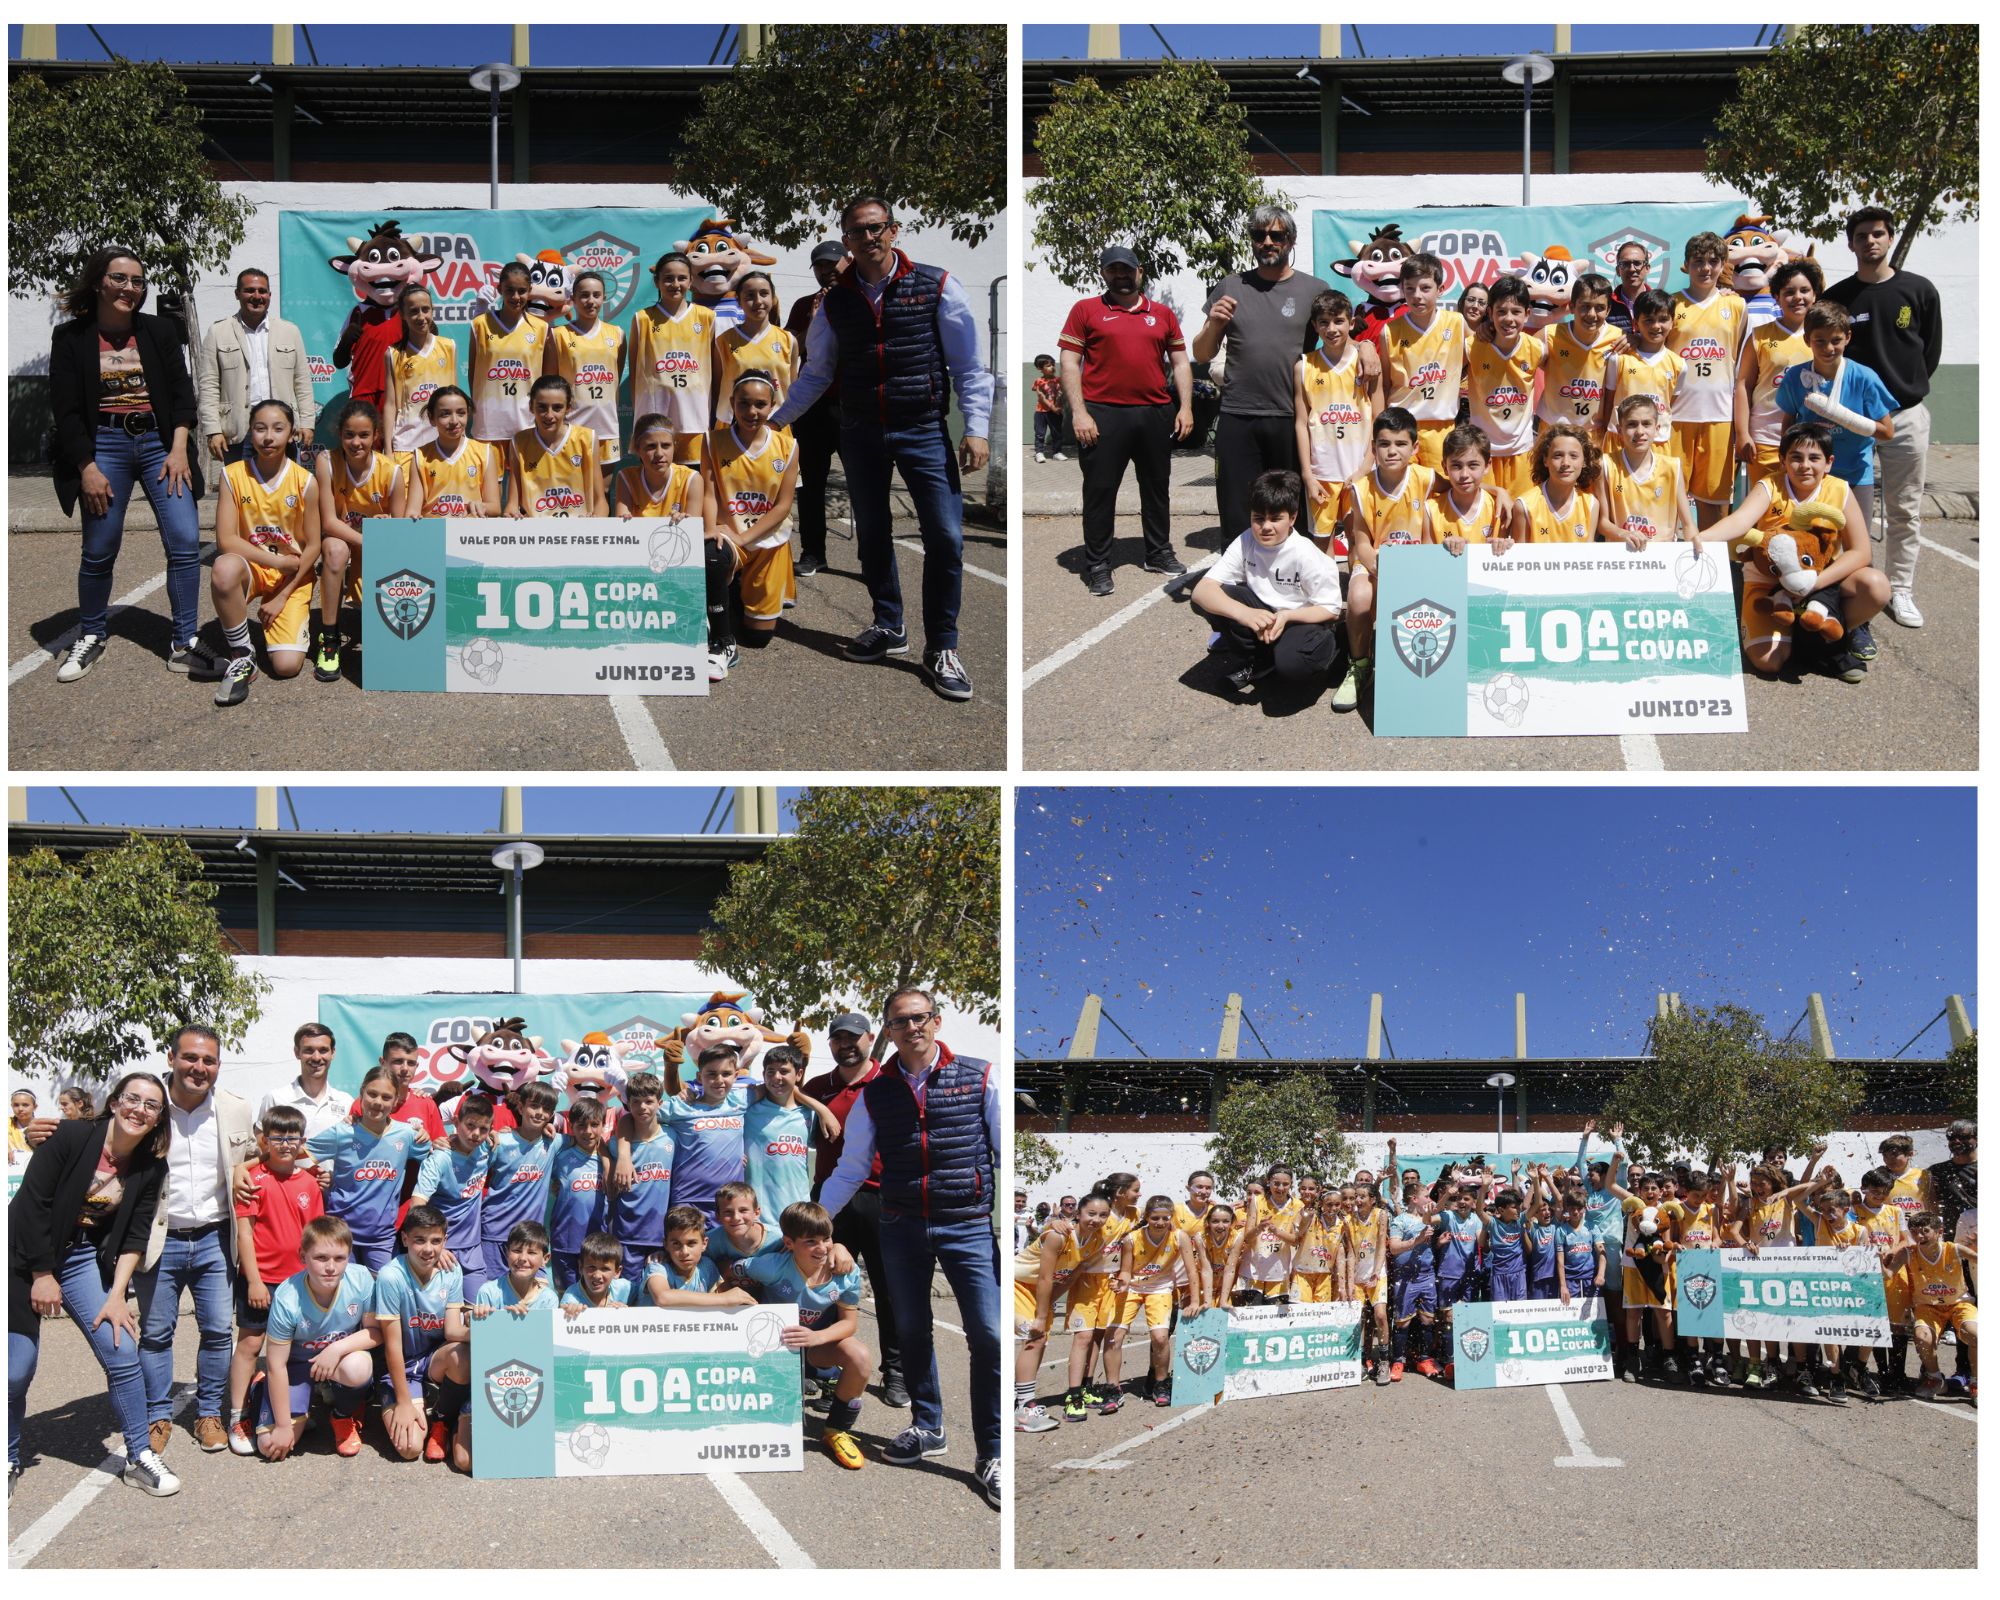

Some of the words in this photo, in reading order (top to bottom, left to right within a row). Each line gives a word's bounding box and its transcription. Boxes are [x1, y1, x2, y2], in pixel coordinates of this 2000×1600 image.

[1420, 233, 1503, 256] COPA
[586, 248, 615, 256] COPA
[577, 256, 623, 269] COVAP
[1691, 338, 1718, 347] COPA
[665, 351, 691, 360] COPA
[1679, 347, 1726, 360] COVAP
[497, 360, 523, 368] COPA
[582, 364, 605, 373] COPA
[655, 359, 699, 373] COVAP
[1694, 363, 1712, 377] 15
[487, 368, 531, 380] COVAP
[575, 372, 614, 385] COVAP
[671, 374, 687, 388] 15
[1571, 379, 1598, 388] COPA
[502, 383, 518, 396] 16
[588, 387, 603, 399] 12
[1420, 387, 1435, 400] 12
[1495, 386, 1518, 395] COPA
[1485, 393, 1528, 406] COVAP
[1328, 403, 1351, 412] COPA
[1574, 402, 1590, 416] 16
[1320, 411, 1362, 424] COVAP
[1503, 408, 1511, 420] 9
[1336, 427, 1344, 439] 5
[545, 488, 571, 496] COPA
[736, 492, 767, 502] COPA
[438, 495, 463, 503] COPA
[536, 495, 584, 511] COVAP
[431, 503, 465, 516] COVA
[459, 536, 490, 545] VALE
[493, 536, 517, 545] POR
[519, 536, 535, 545] UN
[538, 536, 568, 545] PASE
[571, 536, 600, 545] FASE
[602, 536, 640, 545] FINAL
[1389, 531, 1411, 540] COPA
[1482, 562, 1513, 571] VALE
[1515, 561, 1541, 571] POR
[1543, 561, 1561, 571] UN
[1564, 560, 1594, 570] PASE
[1596, 560, 1626, 570] FASE
[1628, 560, 1666, 570] FINAL
[394, 580, 416, 588] COPA
[388, 587, 423, 597] COVAP
[595, 582, 658, 601] COPA
[595, 610, 677, 630] COVAP
[1412, 611, 1436, 619] COPA
[1623, 609, 1689, 629] COPA
[1405, 618, 1443, 629] COVAP
[1625, 639, 1709, 660] COVAP
[624, 1031, 654, 1040] COPA
[694, 1118, 742, 1131] COVAP
[779, 1135, 802, 1143] COPA
[366, 1160, 391, 1168] COPA
[354, 1168, 397, 1181] COVAP
[1766, 1232, 1776, 1241] 10
[1810, 1280, 1852, 1292] COPA
[1811, 1296, 1866, 1308] COVAP
[566, 1325, 596, 1334] VALE
[598, 1324, 621, 1334] POR
[623, 1324, 639, 1333] UN
[642, 1324, 670, 1333] PASE
[673, 1323, 701, 1332] FASE
[703, 1323, 739, 1332] FINAL
[1561, 1327, 1589, 1337] COPA
[1307, 1332, 1340, 1344] COPA
[1562, 1340, 1597, 1351] COVAP
[1307, 1345, 1347, 1359] COVAP
[497, 1377, 531, 1387] COVAP
[696, 1367, 756, 1385] COPA
[696, 1393, 773, 1411] COVAP
